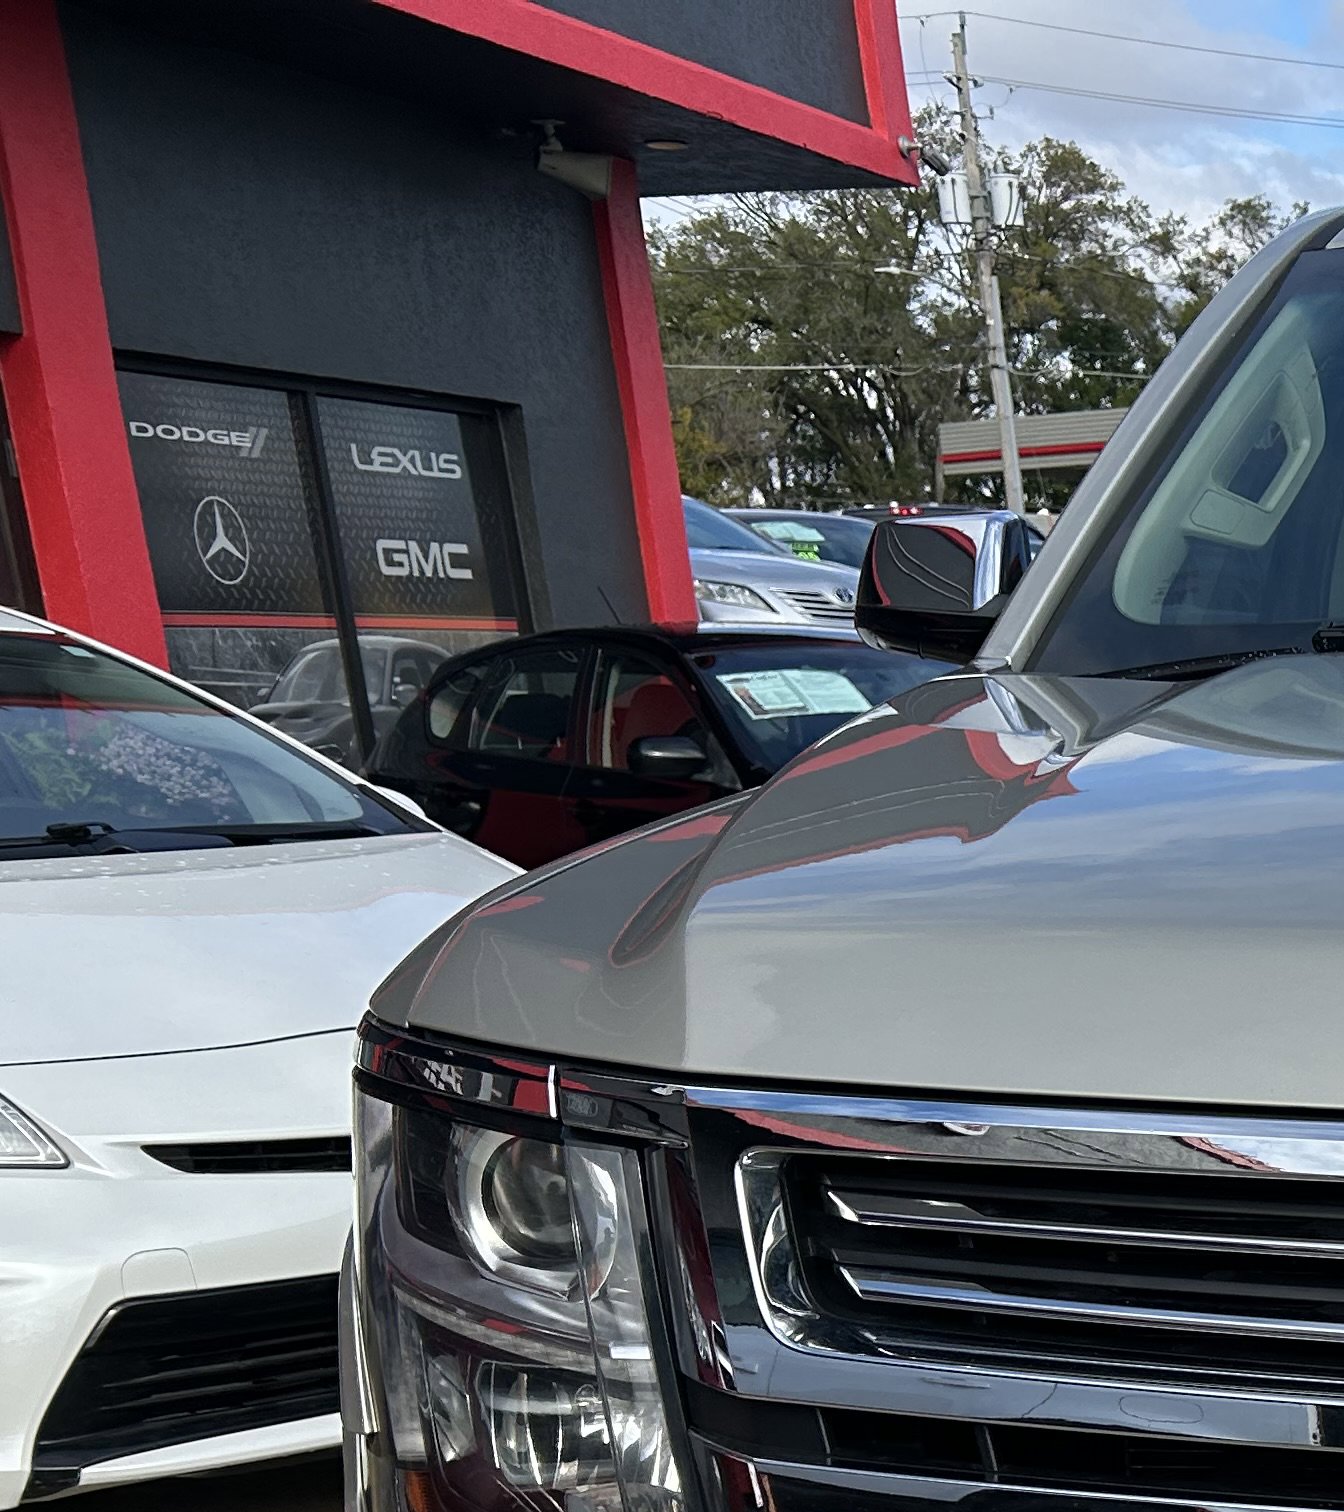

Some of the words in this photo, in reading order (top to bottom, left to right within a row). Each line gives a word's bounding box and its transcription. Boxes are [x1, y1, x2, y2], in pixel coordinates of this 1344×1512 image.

[129, 421, 252, 447] DODGE
[350, 443, 462, 479] LEXUS
[376, 538, 473, 579] GMC
